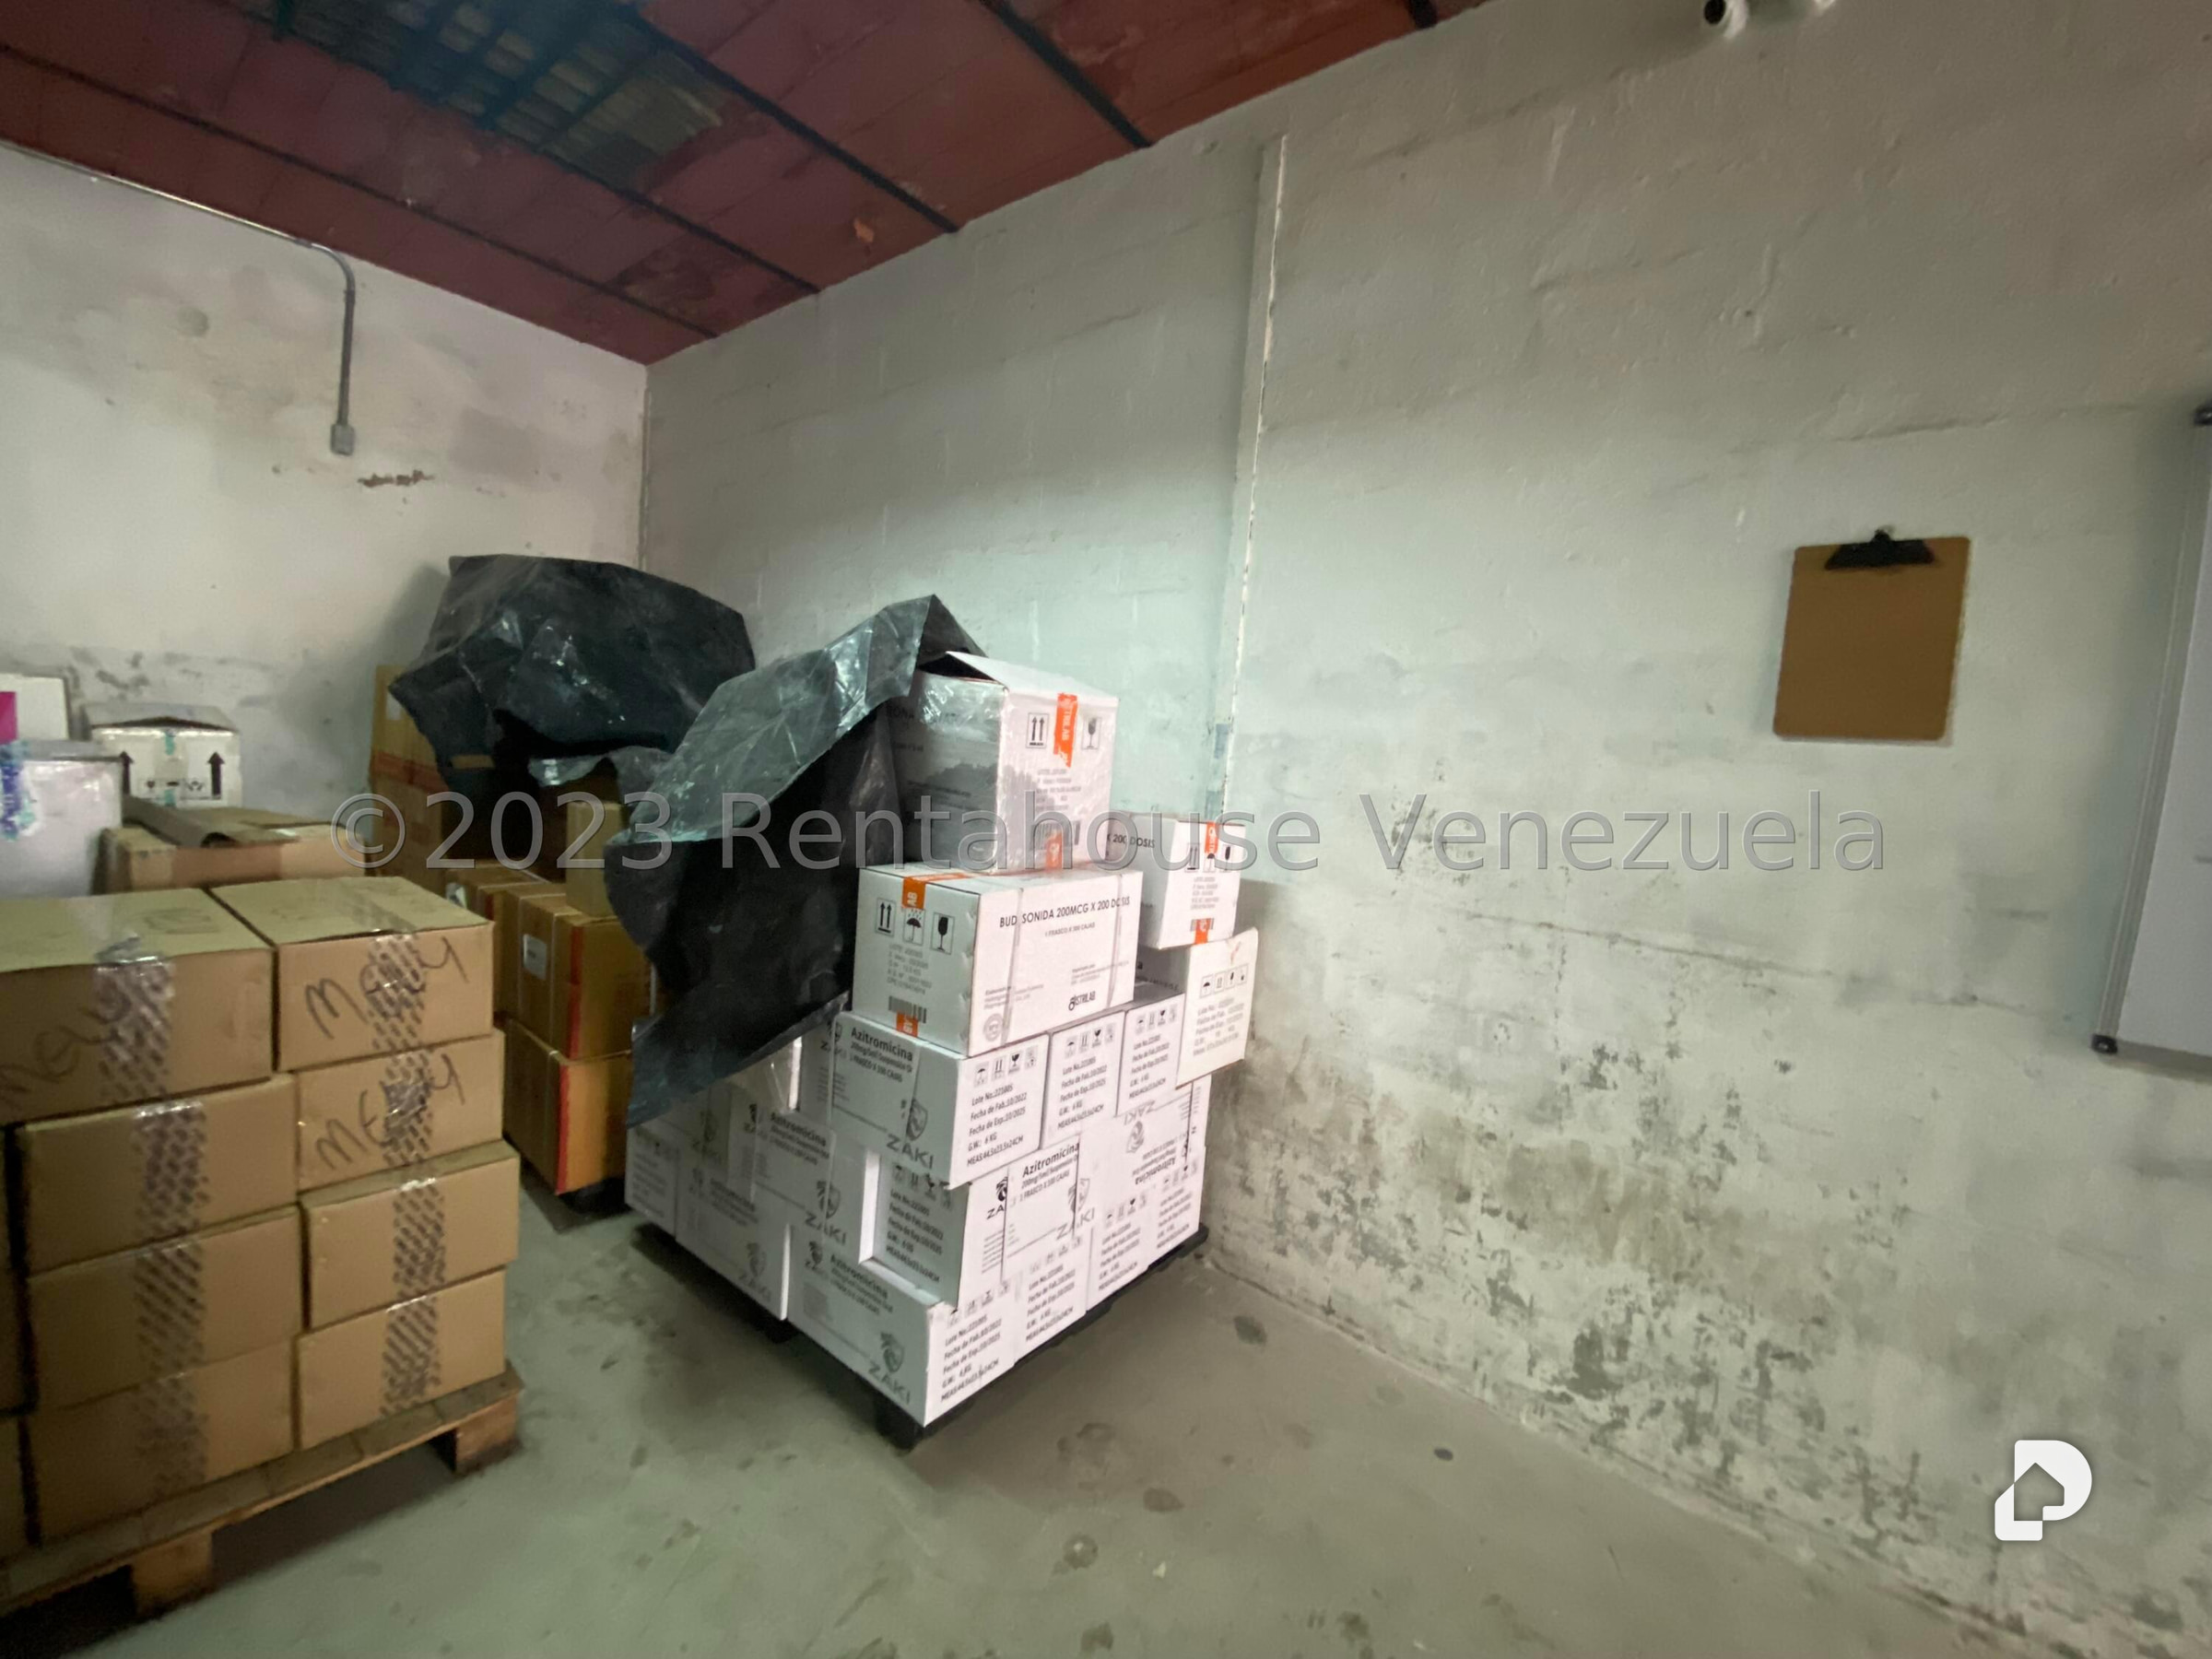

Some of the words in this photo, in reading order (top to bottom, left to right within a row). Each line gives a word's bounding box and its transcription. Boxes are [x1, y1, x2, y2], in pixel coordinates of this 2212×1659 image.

[1056, 902, 1088, 918] 200MCG
[1090, 900, 1096, 912] X
[1098, 900, 1110, 911] 200
[851, 1027, 912, 1062] Azitromicina
[971, 1095, 984, 1106] Lote
[971, 1110, 987, 1122] Fecha
[969, 1124, 986, 1136] Fecha
[886, 1133, 934, 1170] ZAKI
